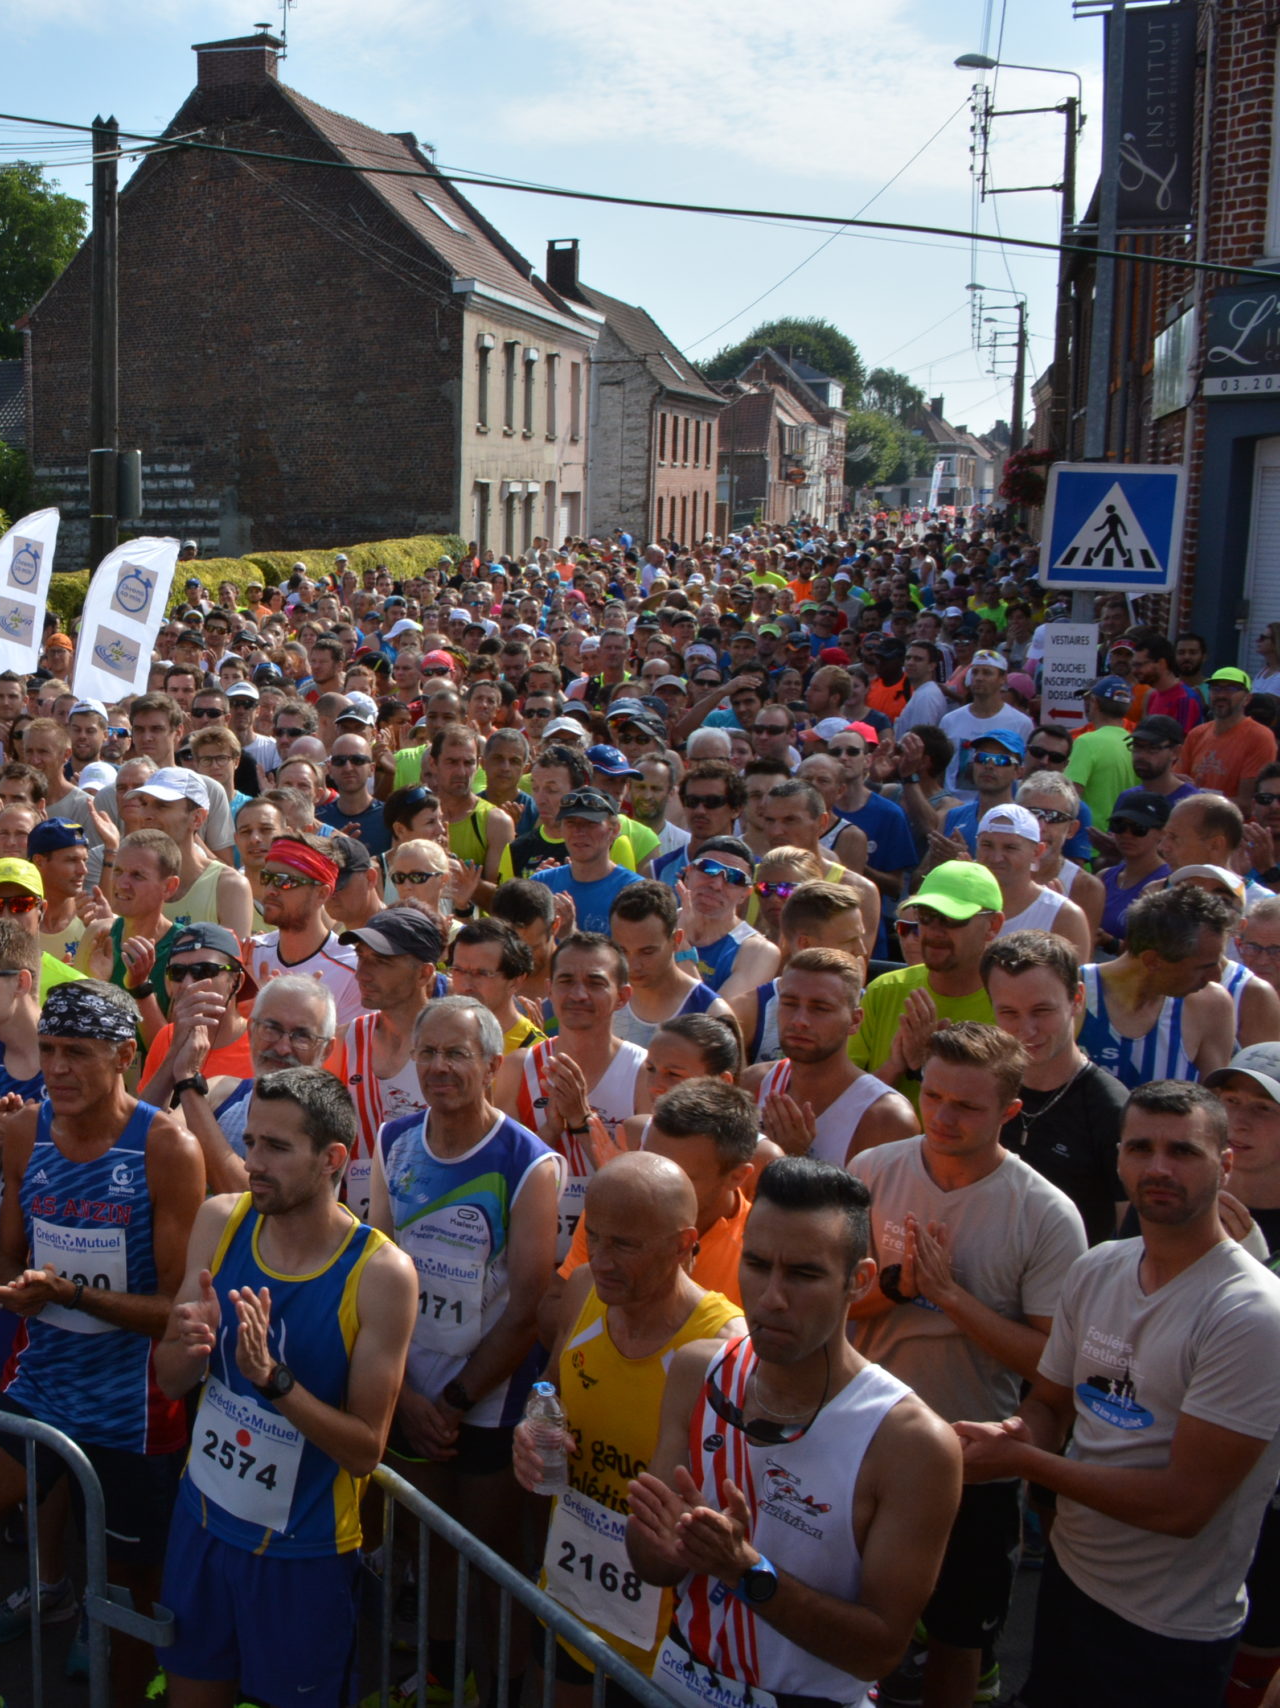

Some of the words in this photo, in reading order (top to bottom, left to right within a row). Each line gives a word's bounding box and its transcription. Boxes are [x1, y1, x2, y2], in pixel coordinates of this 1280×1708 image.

[1146, 22, 1167, 148] INSTITUT
[1050, 635, 1090, 646] VESTIAIRES
[1051, 662, 1086, 673] DOUCHES
[351, 1165, 371, 1177] Créd
[31, 1195, 57, 1216] AS
[63, 1198, 133, 1225] ANZIN
[449, 1217, 484, 1233] Kalenji
[35, 1227, 62, 1245] Crédit
[75, 1236, 120, 1249] Mutuel
[437, 1262, 479, 1279] Mutuel
[208, 1385, 237, 1416] Crédit
[251, 1414, 300, 1443] Mutuel
[202, 1429, 278, 1492] 2574
[591, 1440, 649, 1479] gauc
[563, 1493, 596, 1525] Crédit
[557, 1539, 643, 1603] 2168
